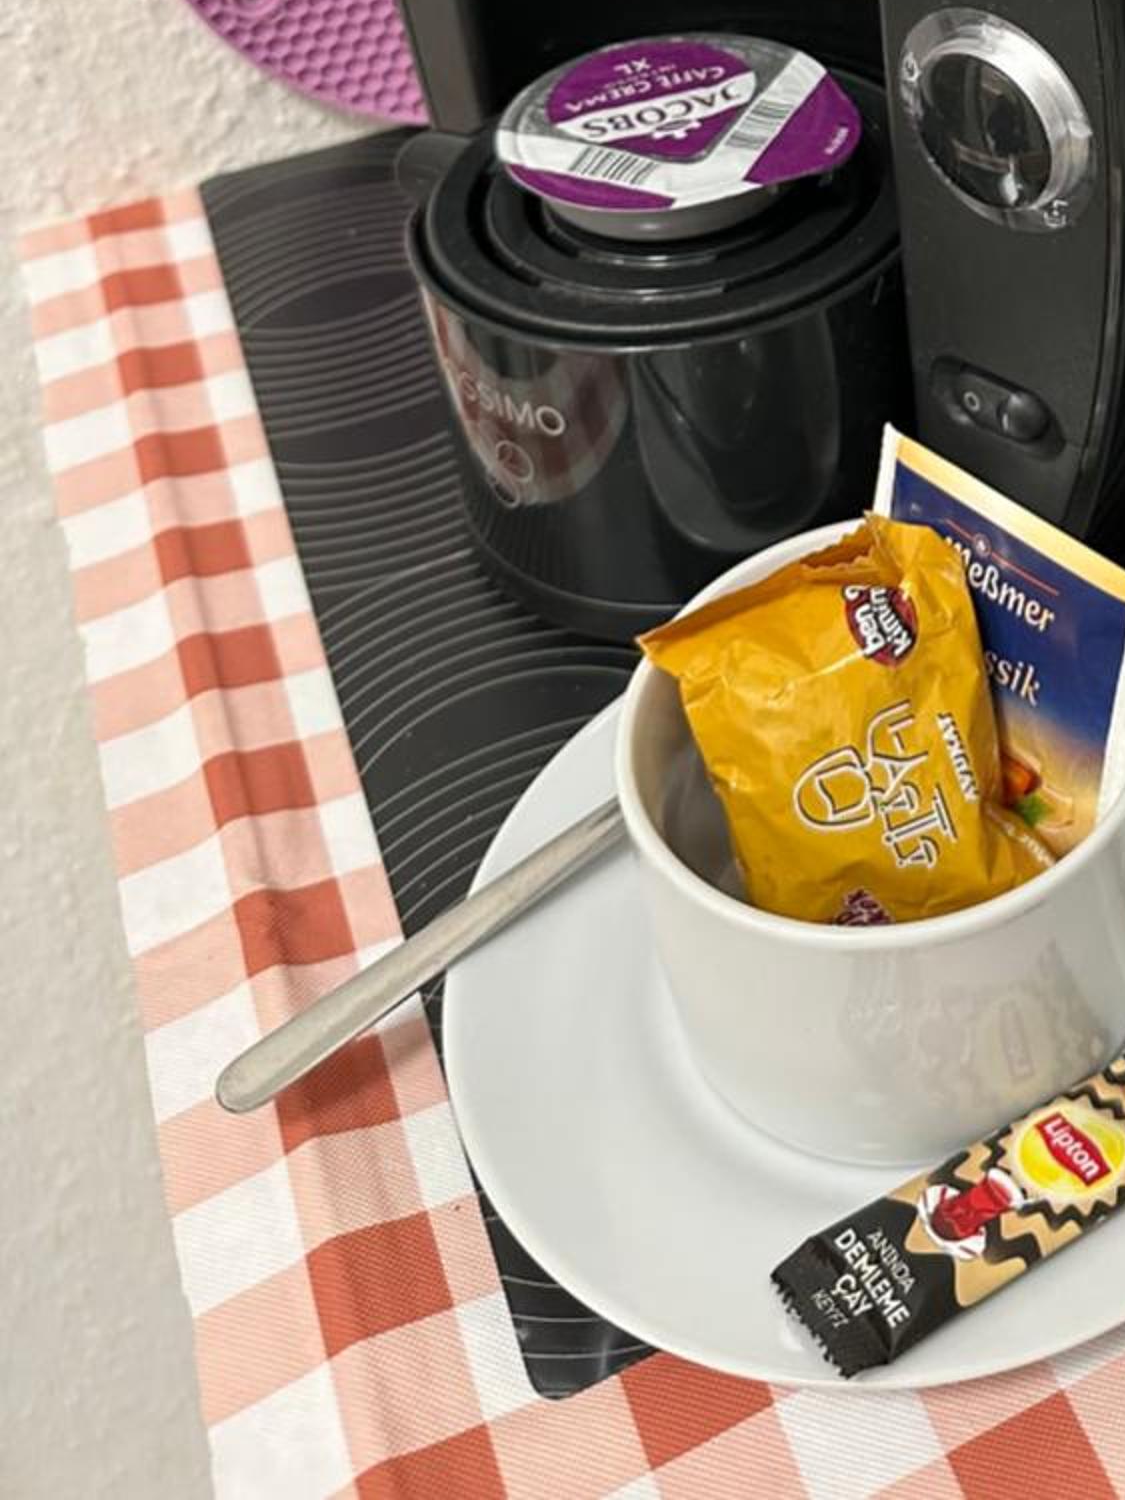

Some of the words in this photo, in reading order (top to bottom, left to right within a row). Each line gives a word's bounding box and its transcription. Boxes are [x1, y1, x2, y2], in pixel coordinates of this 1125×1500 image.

[613, 57, 651, 76] XL
[564, 81, 652, 113] CREMA
[582, 86, 743, 138] JACOBS
[460, 371, 567, 437] SSIMO
[854, 603, 886, 655] ben
[983, 651, 1041, 707] ssik
[936, 712, 981, 803] AVUKAT
[1044, 1117, 1101, 1182] Lipton
[834, 1227, 911, 1328] DEMLEME
[867, 1226, 916, 1295] ANINDA
[830, 1274, 874, 1317] ÇAY
